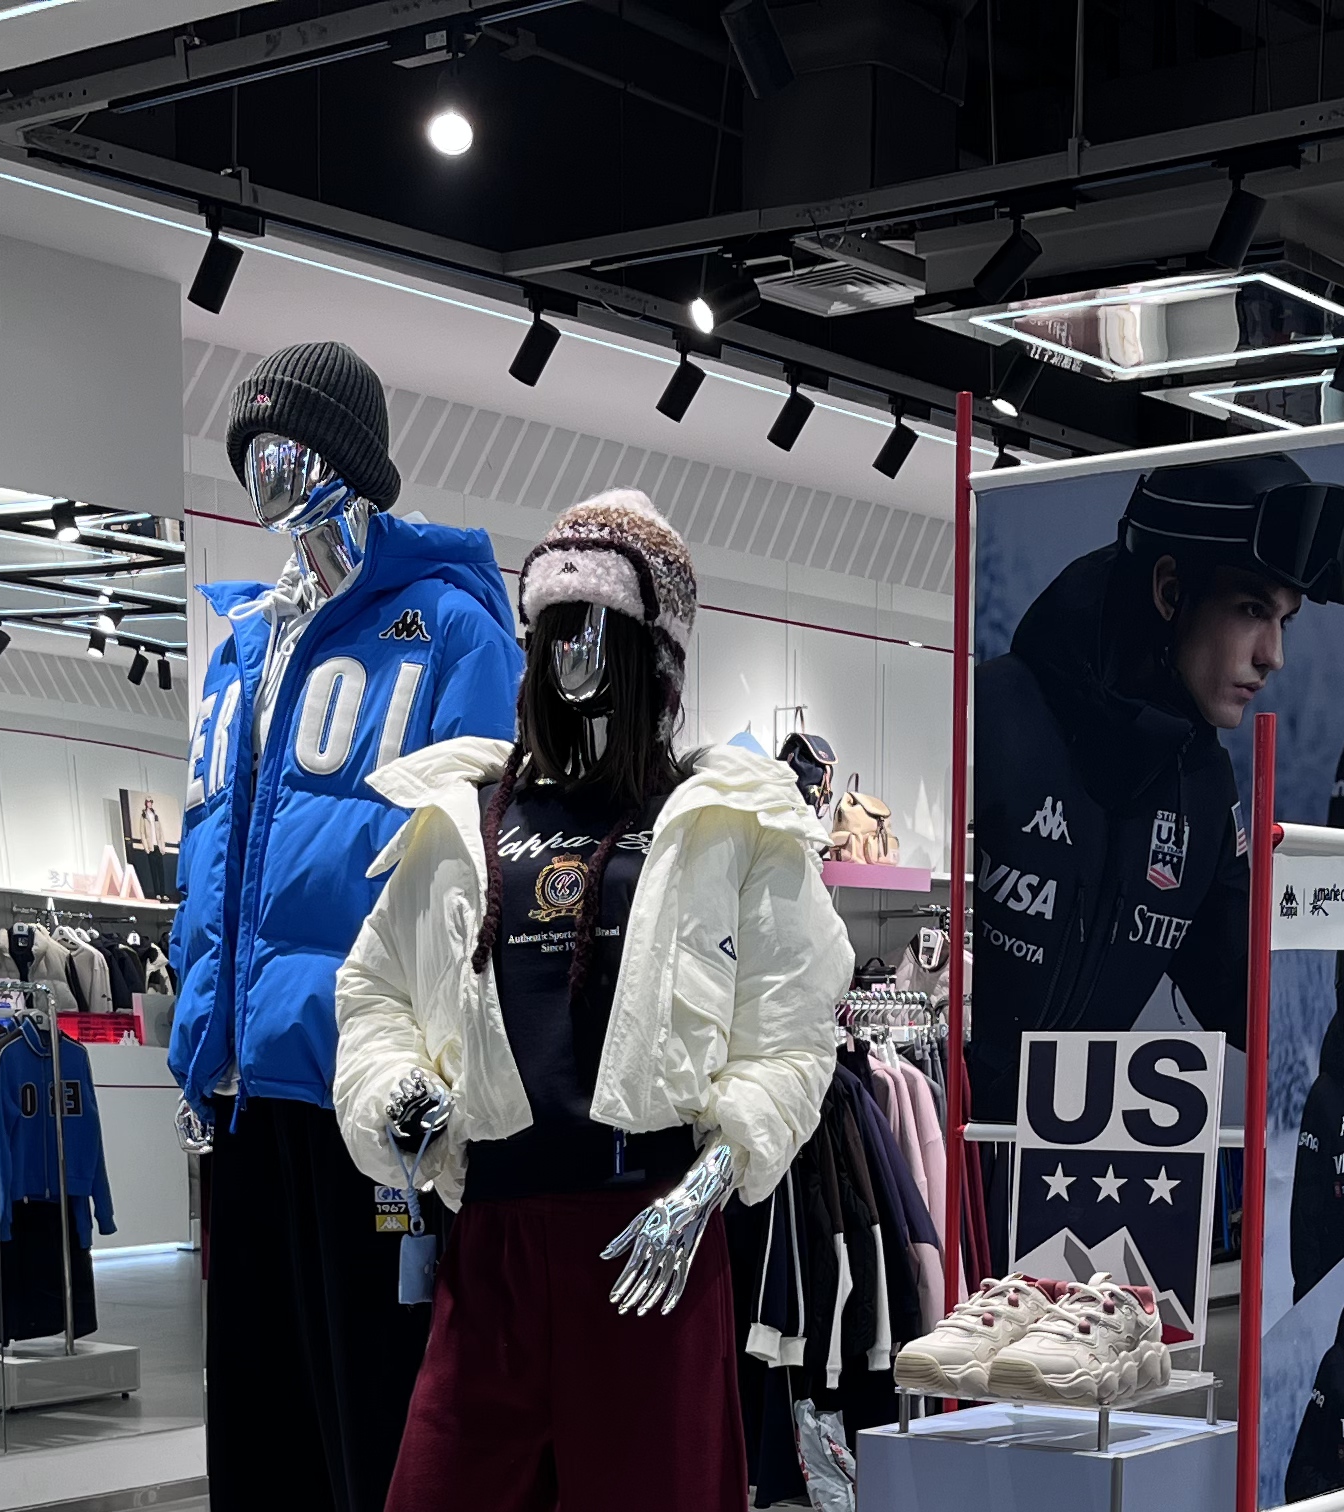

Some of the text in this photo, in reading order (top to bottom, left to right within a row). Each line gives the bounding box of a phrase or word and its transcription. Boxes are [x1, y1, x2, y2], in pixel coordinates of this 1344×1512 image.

[977, 848, 1057, 921] VISA
[507, 931, 548, 944] Authentic
[540, 942, 565, 953] Since
[981, 920, 1044, 965] TOYOTA
[1025, 1038, 1209, 1148] US
[376, 1204, 406, 1213] 1967
